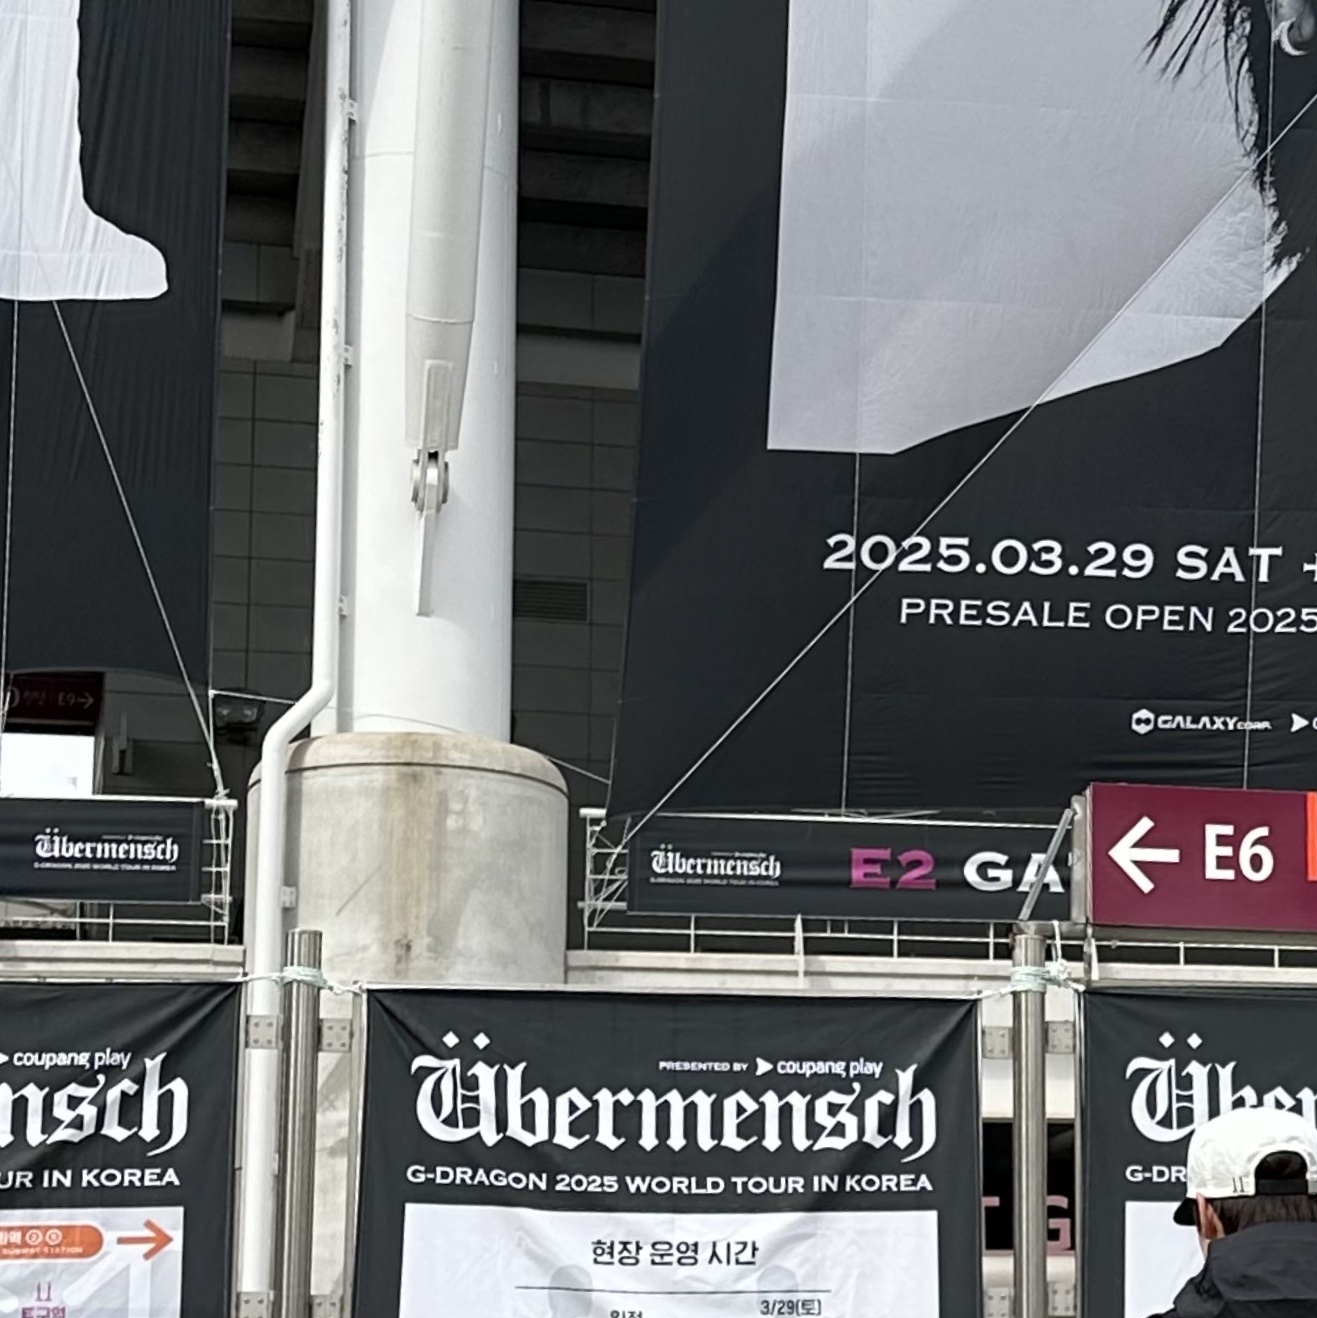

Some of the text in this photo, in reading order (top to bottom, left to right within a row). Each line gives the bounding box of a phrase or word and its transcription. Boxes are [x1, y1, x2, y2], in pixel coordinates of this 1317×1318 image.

[823, 533, 1155, 578] 2025.03.29
[1176, 544, 1283, 583] SAT
[899, 598, 1091, 628] PRESALE
[1104, 603, 1214, 632] OPEN
[34, 828, 179, 862] Übermensch
[650, 844, 782, 880] Übermensch
[1203, 821, 1275, 885] E6
[849, 846, 1073, 894] E2 GA
[13, 1048, 131, 1070] coupang play
[659, 1057, 883, 1077] PRESENTED BY coupang play
[410, 1030, 937, 1162] Übermensch
[43, 1169, 72, 1188] IN
[81, 1168, 180, 1188] KOREA
[406, 1165, 933, 1194] G-DRAGON 2025 WORLD TOUR IN KOREA
[591, 1239, 759, 1267] 현장 운영 시간
